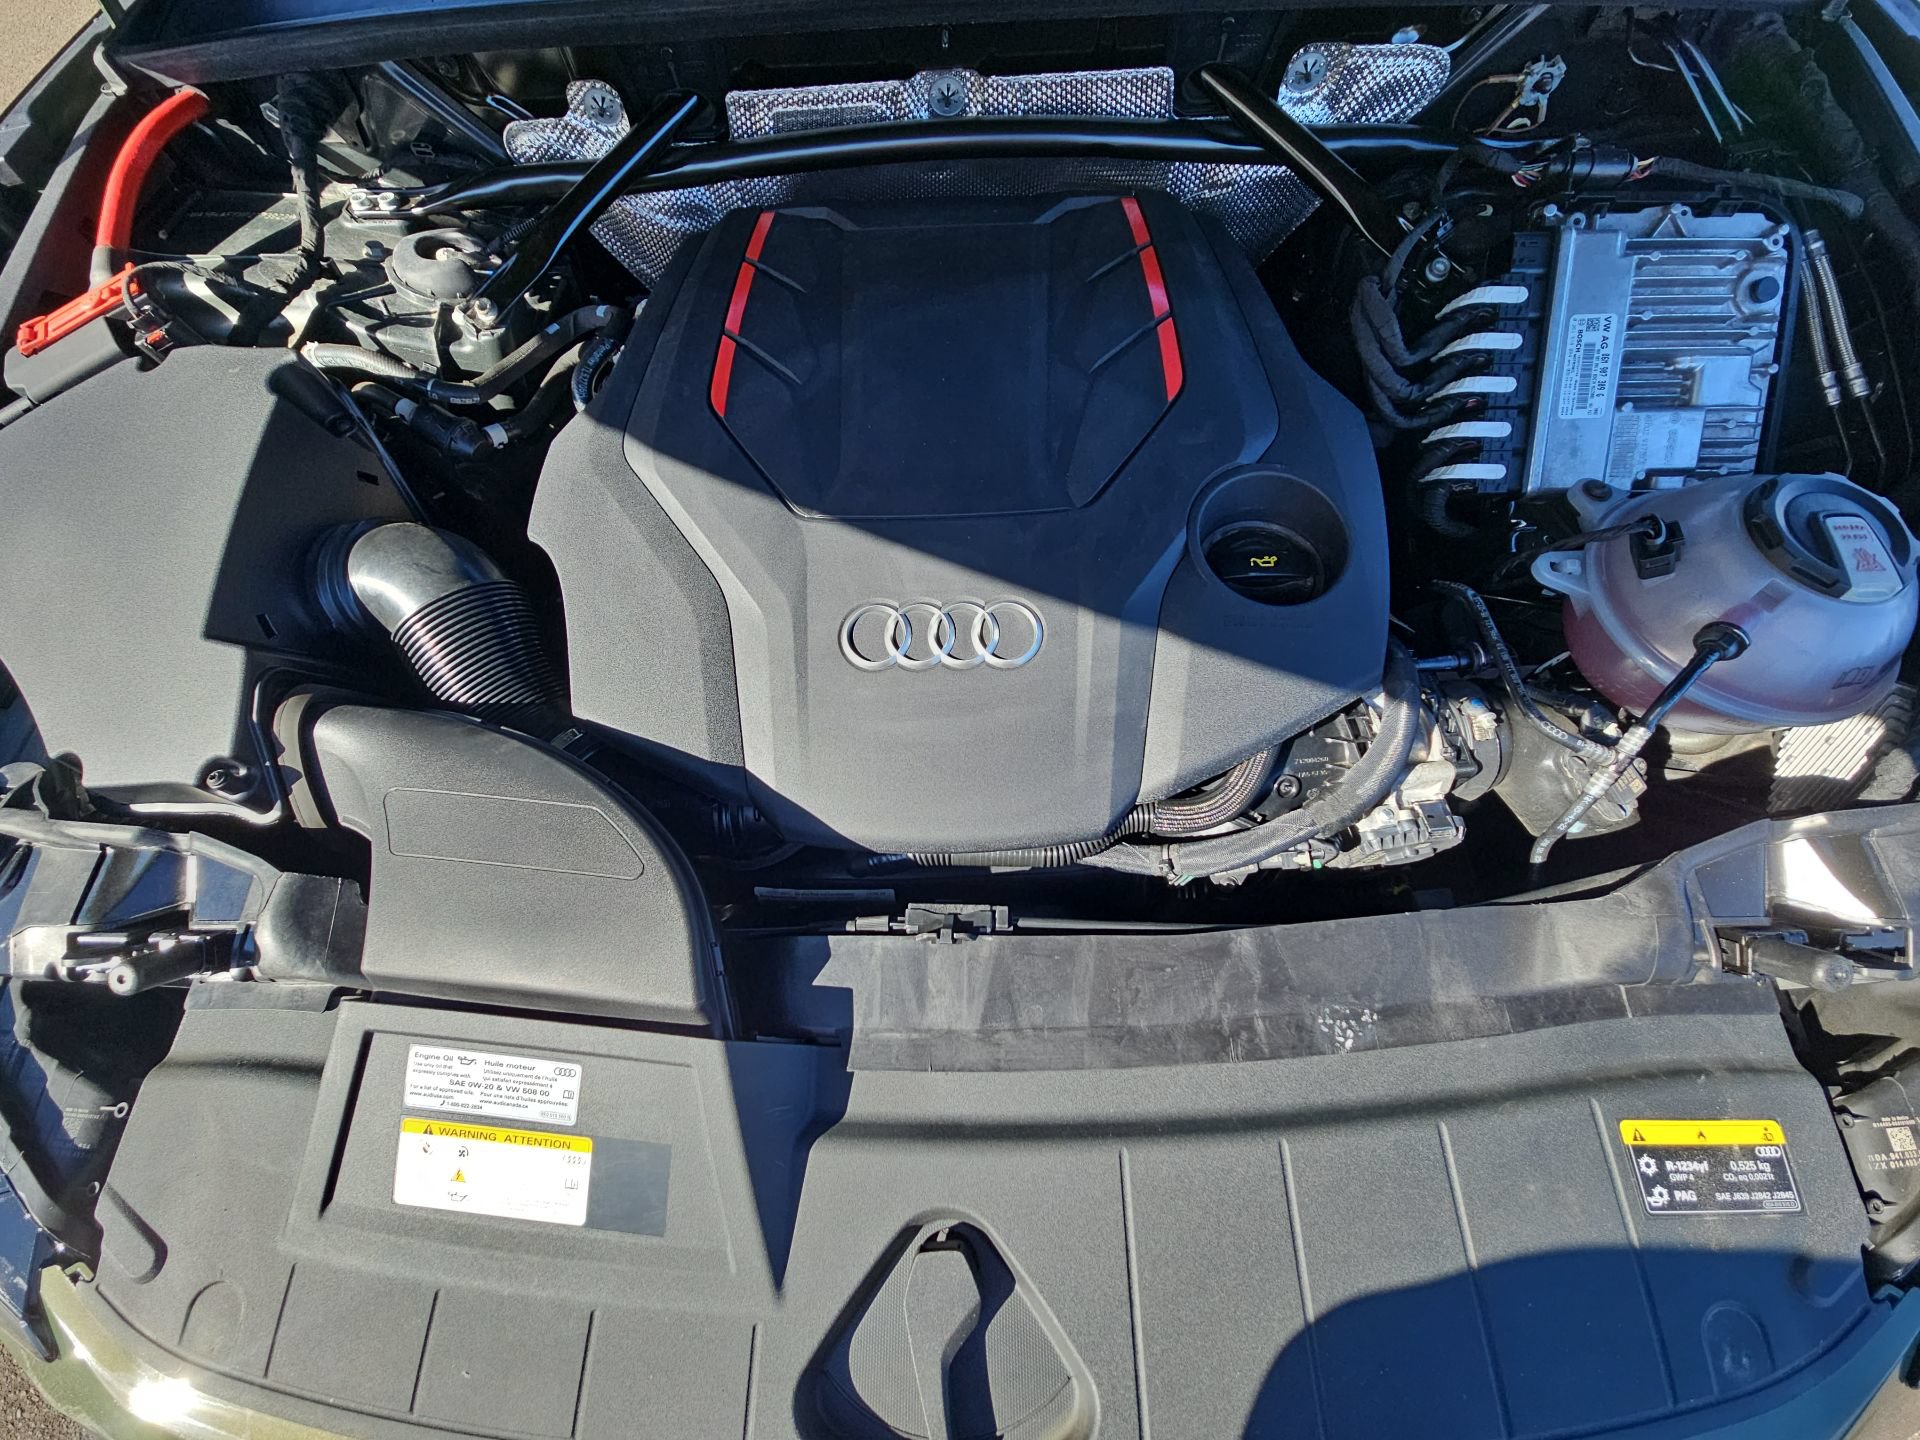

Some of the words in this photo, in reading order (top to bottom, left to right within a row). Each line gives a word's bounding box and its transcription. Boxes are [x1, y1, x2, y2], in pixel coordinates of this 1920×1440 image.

[1602, 315, 1611, 332] VW
[1574, 329, 1583, 352] BOSCH
[1600, 335, 1608, 349] AG
[414, 1051, 440, 1061] Engine
[485, 1059, 503, 1067] Huile
[506, 1062, 535, 1071] moteur
[467, 1081, 493, 1089] 0W-20
[522, 1087, 537, 1095] 508
[439, 1127, 497, 1142] WARNING
[504, 1134, 572, 1150] ATTENTION
[1756, 1160, 1770, 1171] kg
[1673, 1190, 1697, 1200] PAG
[1715, 1192, 1731, 1200] SAE
